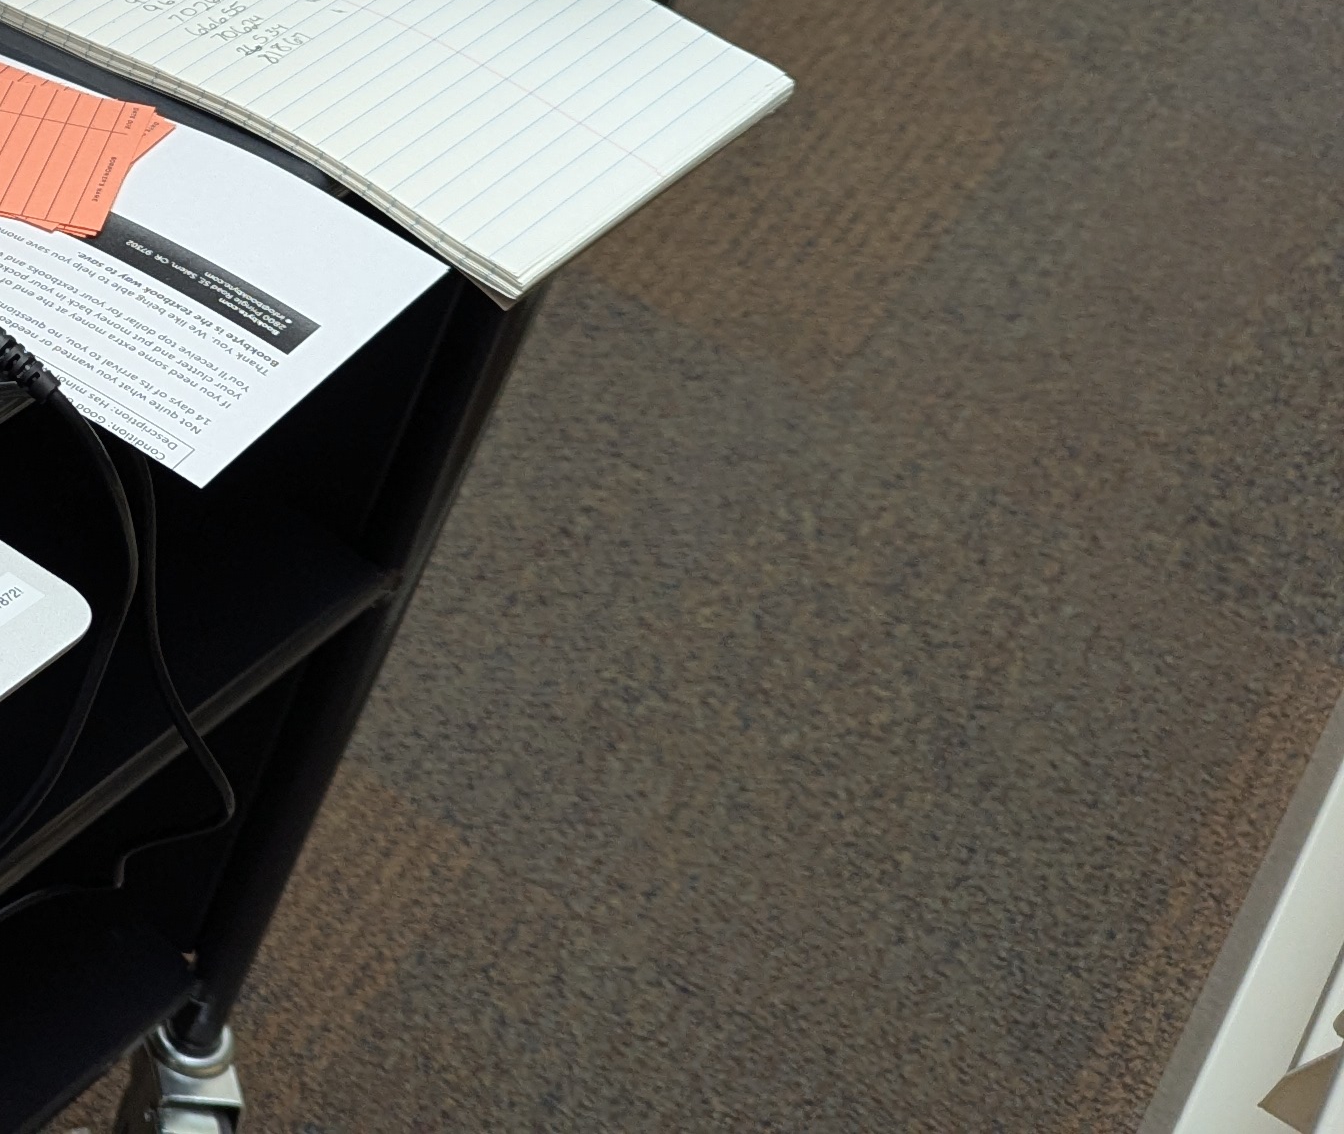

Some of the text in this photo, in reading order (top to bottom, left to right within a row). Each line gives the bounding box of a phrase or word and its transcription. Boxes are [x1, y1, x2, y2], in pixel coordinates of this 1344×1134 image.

[144, 285, 280, 368] Bookbyte textbook
[219, 297, 281, 336] Bookbyte.com
[212, 336, 269, 377] Thank You.
[111, 406, 178, 451] Description:
[149, 397, 202, 435] Not quite
[169, 397, 212, 426] 14 days
[107, 422, 166, 461] Condition:
